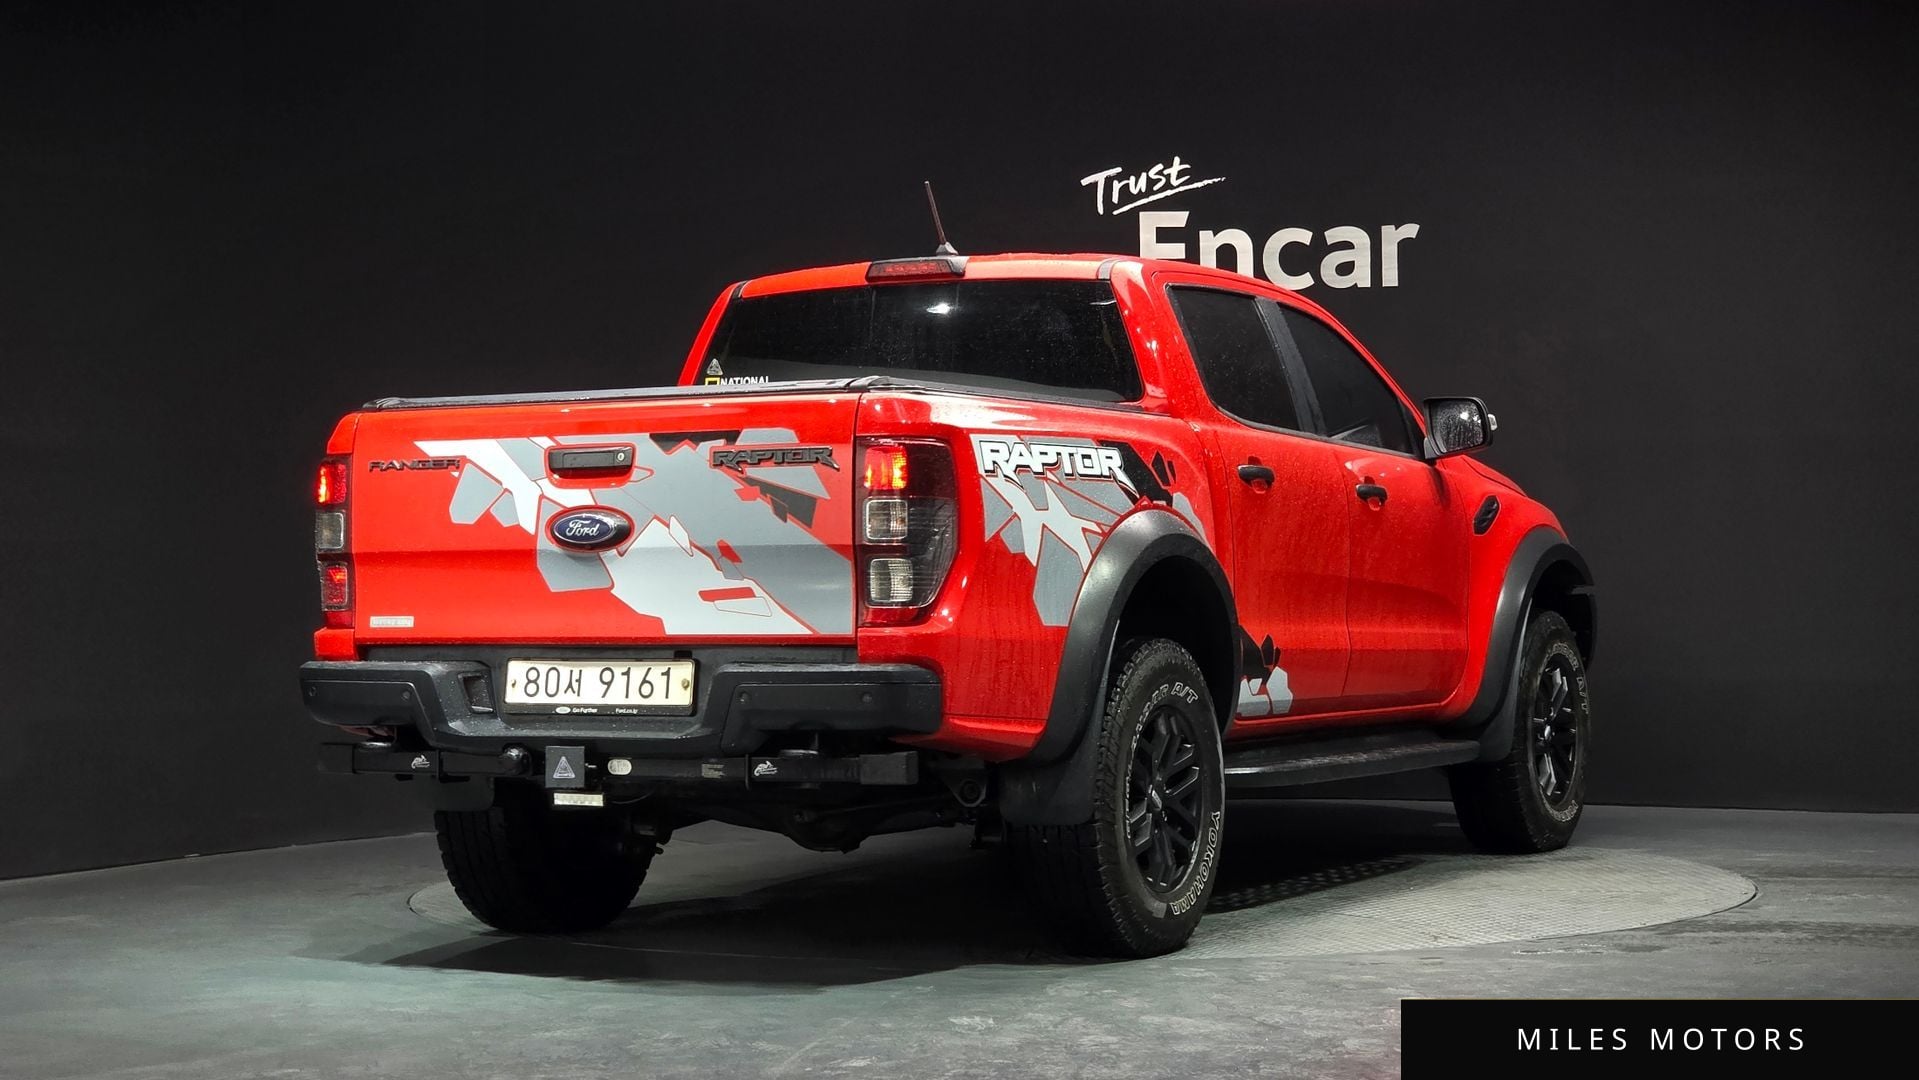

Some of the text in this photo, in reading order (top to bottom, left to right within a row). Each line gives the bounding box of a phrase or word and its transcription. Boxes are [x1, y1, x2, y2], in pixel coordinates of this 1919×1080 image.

[1081, 156, 1191, 215] Trust
[1138, 211, 1420, 291] Encar
[369, 458, 460, 473] RANGER
[711, 446, 840, 473] RAPTOR
[979, 439, 1139, 496] RAPTOR
[565, 519, 600, 538] Ford
[523, 666, 672, 699] 80서 9161
[1169, 811, 1221, 915] YOKOHAMA
